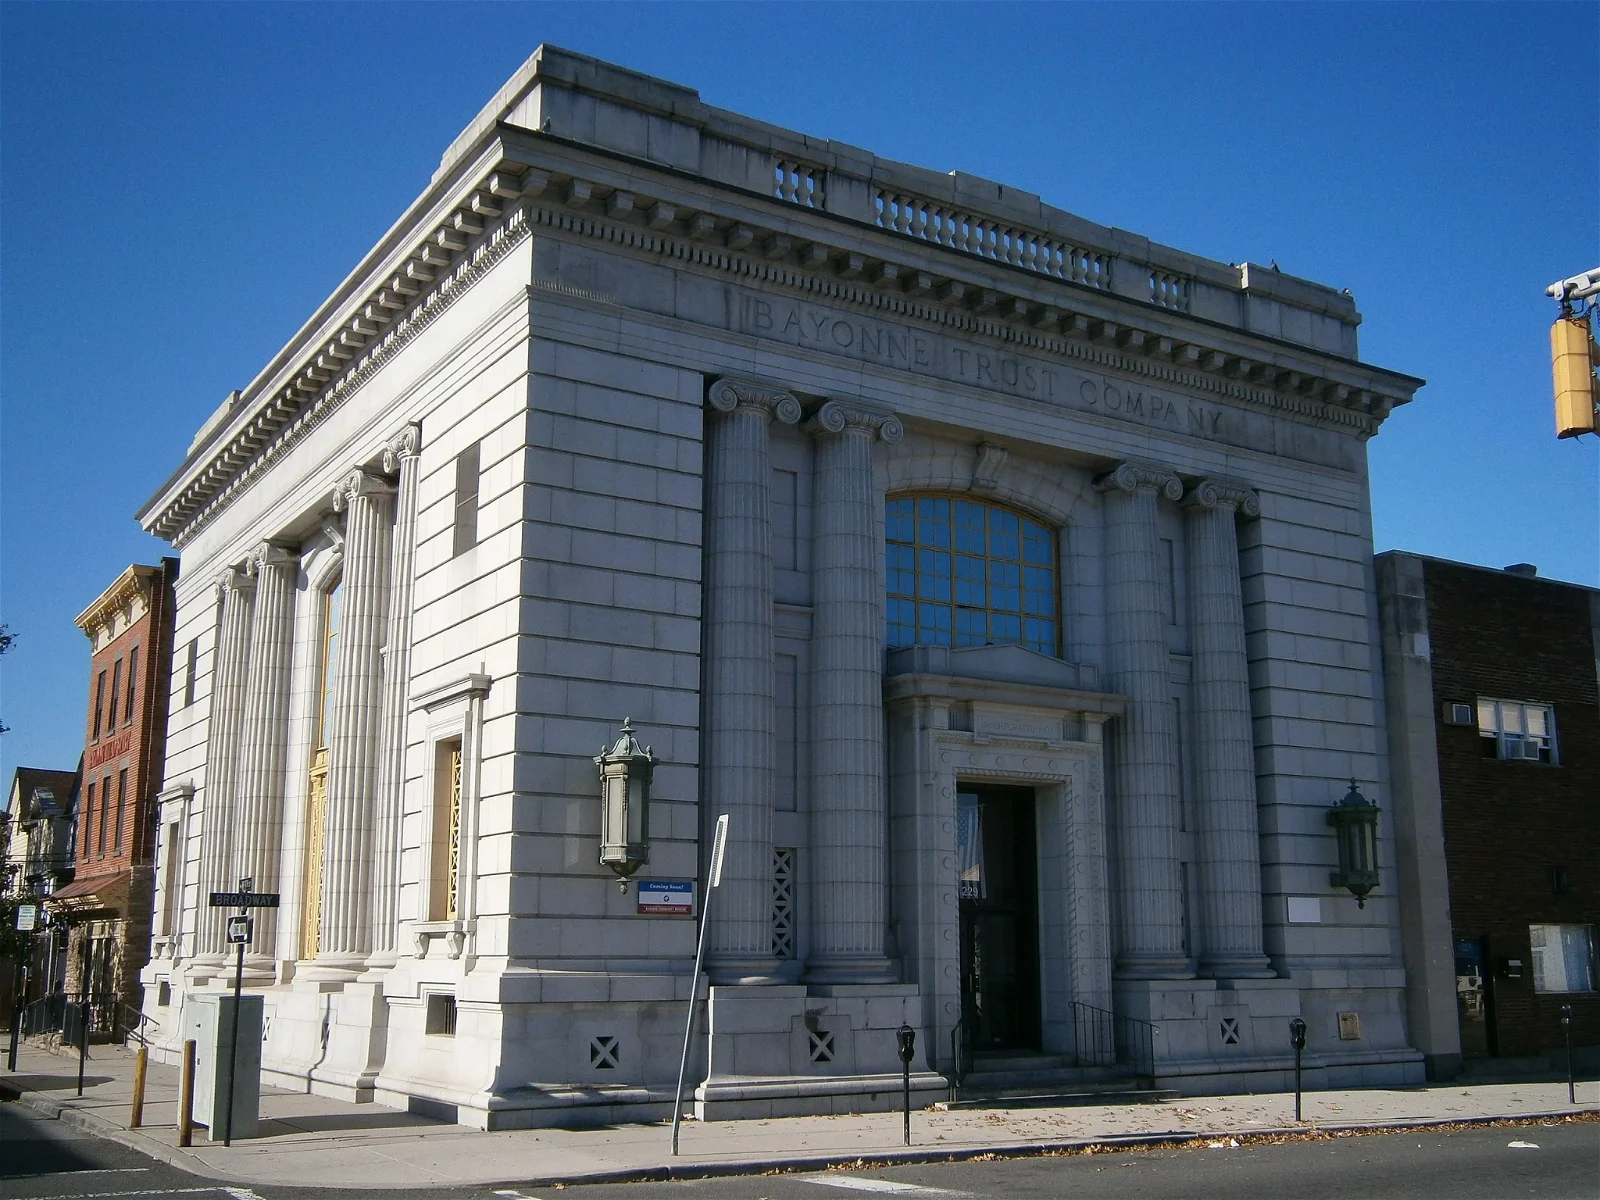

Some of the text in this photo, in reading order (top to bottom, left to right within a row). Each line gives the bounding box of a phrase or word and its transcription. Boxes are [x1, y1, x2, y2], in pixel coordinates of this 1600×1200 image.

[752, 297, 1224, 435] BAYONNE TRUST COMPANY
[961, 886, 979, 896] 229
[216, 894, 273, 906] BROADWAY
